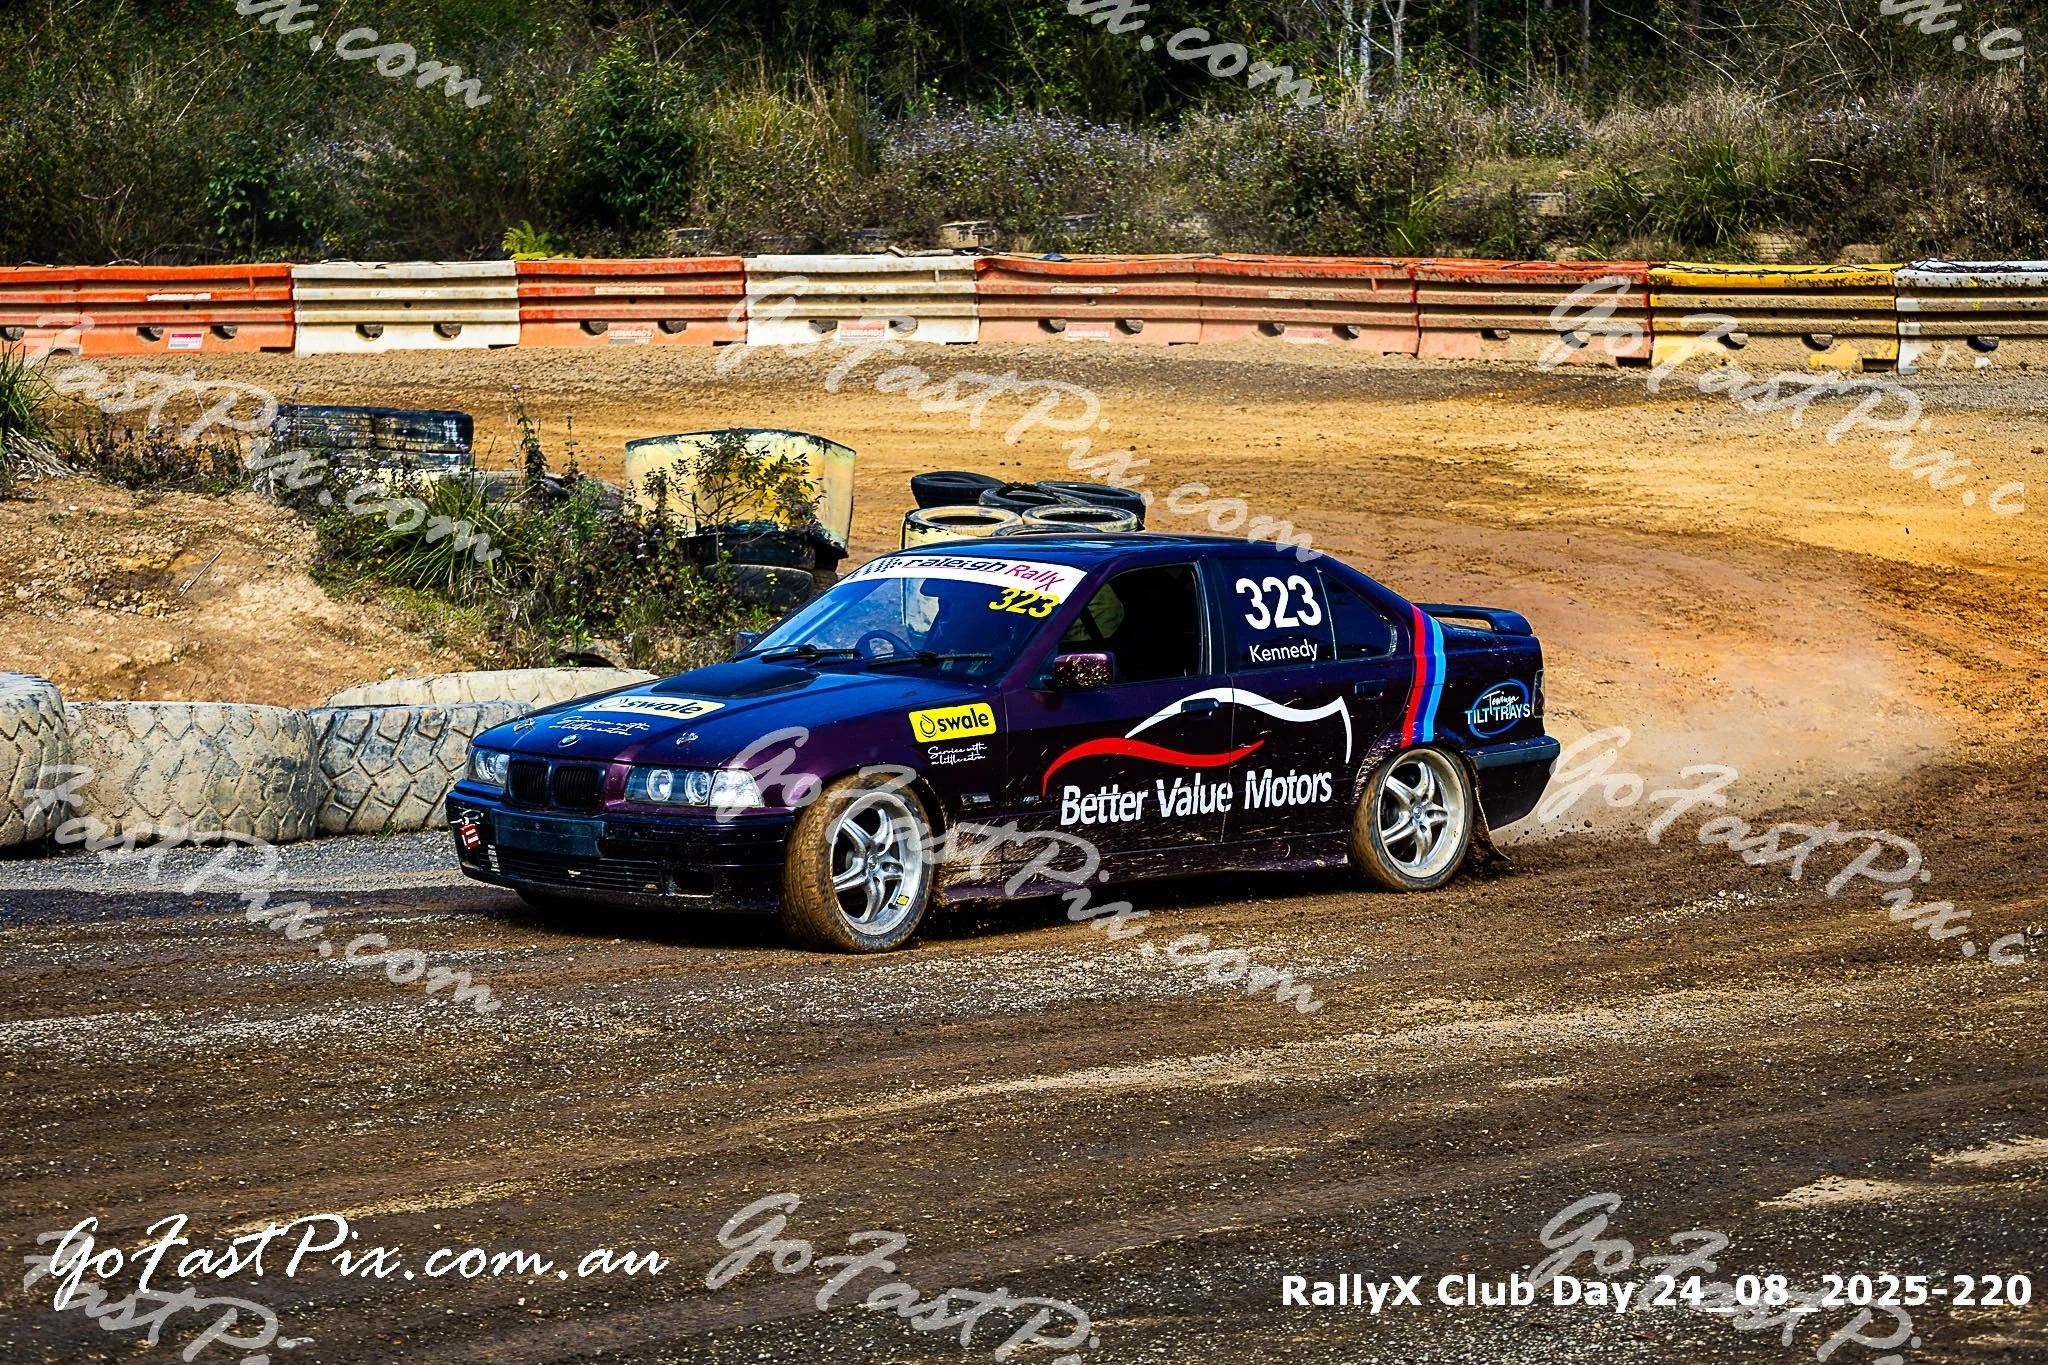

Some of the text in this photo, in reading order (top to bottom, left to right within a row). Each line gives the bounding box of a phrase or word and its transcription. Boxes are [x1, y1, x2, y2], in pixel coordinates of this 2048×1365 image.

[902, 557, 1008, 573] raleigh
[988, 587, 1060, 618] 323
[1235, 574, 1322, 630] 323
[1249, 639, 1318, 662] Kennedy
[621, 701, 704, 714] swale
[938, 707, 990, 732] swale
[1465, 703, 1531, 724] TILT TRAYS
[1060, 768, 1332, 826] Better Value Motors
